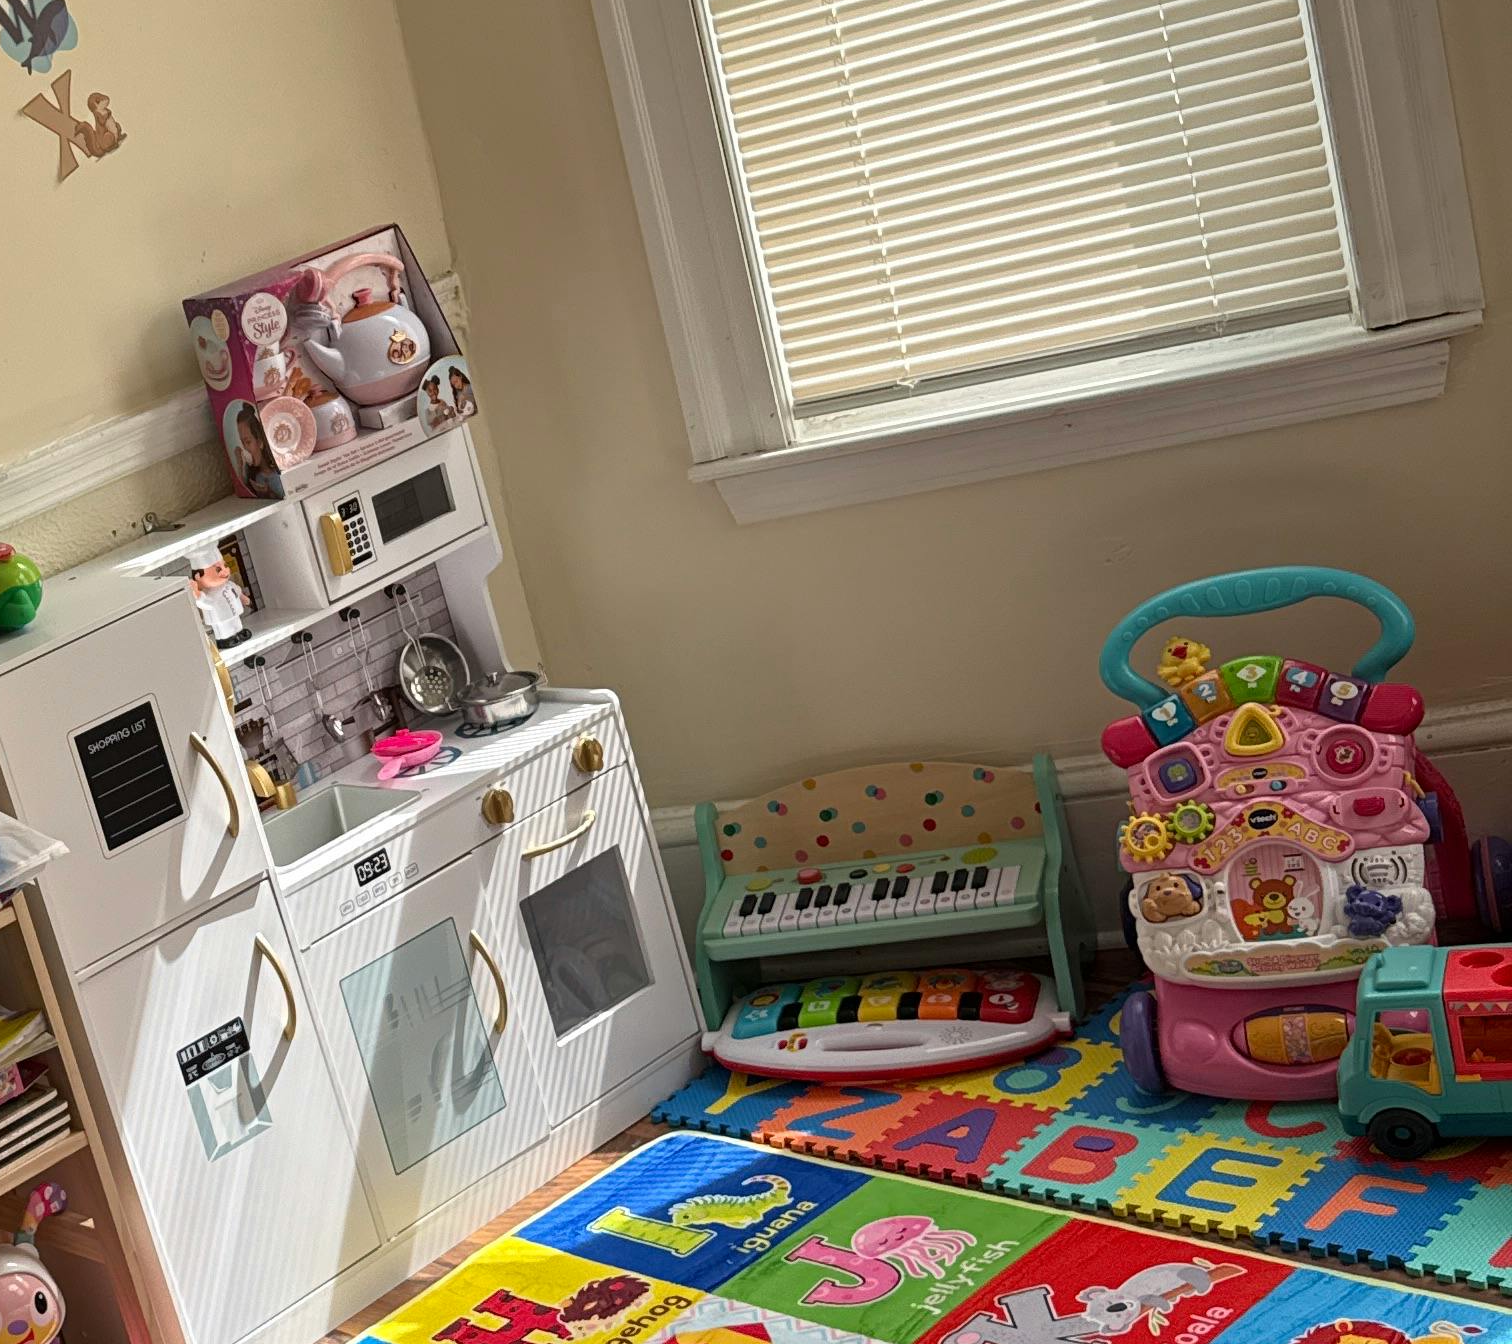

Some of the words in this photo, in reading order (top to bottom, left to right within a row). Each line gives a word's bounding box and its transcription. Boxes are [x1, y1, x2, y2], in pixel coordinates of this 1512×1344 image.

[22, 69, 93, 179] X
[253, 319, 280, 339] Style
[87, 724, 132, 755] SHOPPING
[133, 717, 148, 736] LIST
[356, 852, 389, 882] 09:23
[893, 1108, 997, 1163] A
[1020, 1125, 1140, 1184] B
[1155, 1147, 1284, 1214] E
[1304, 1174, 1429, 1231] F
[735, 1199, 819, 1256] iguana
[783, 1232, 892, 1310] J
[909, 1236, 1022, 1317] jellyfish
